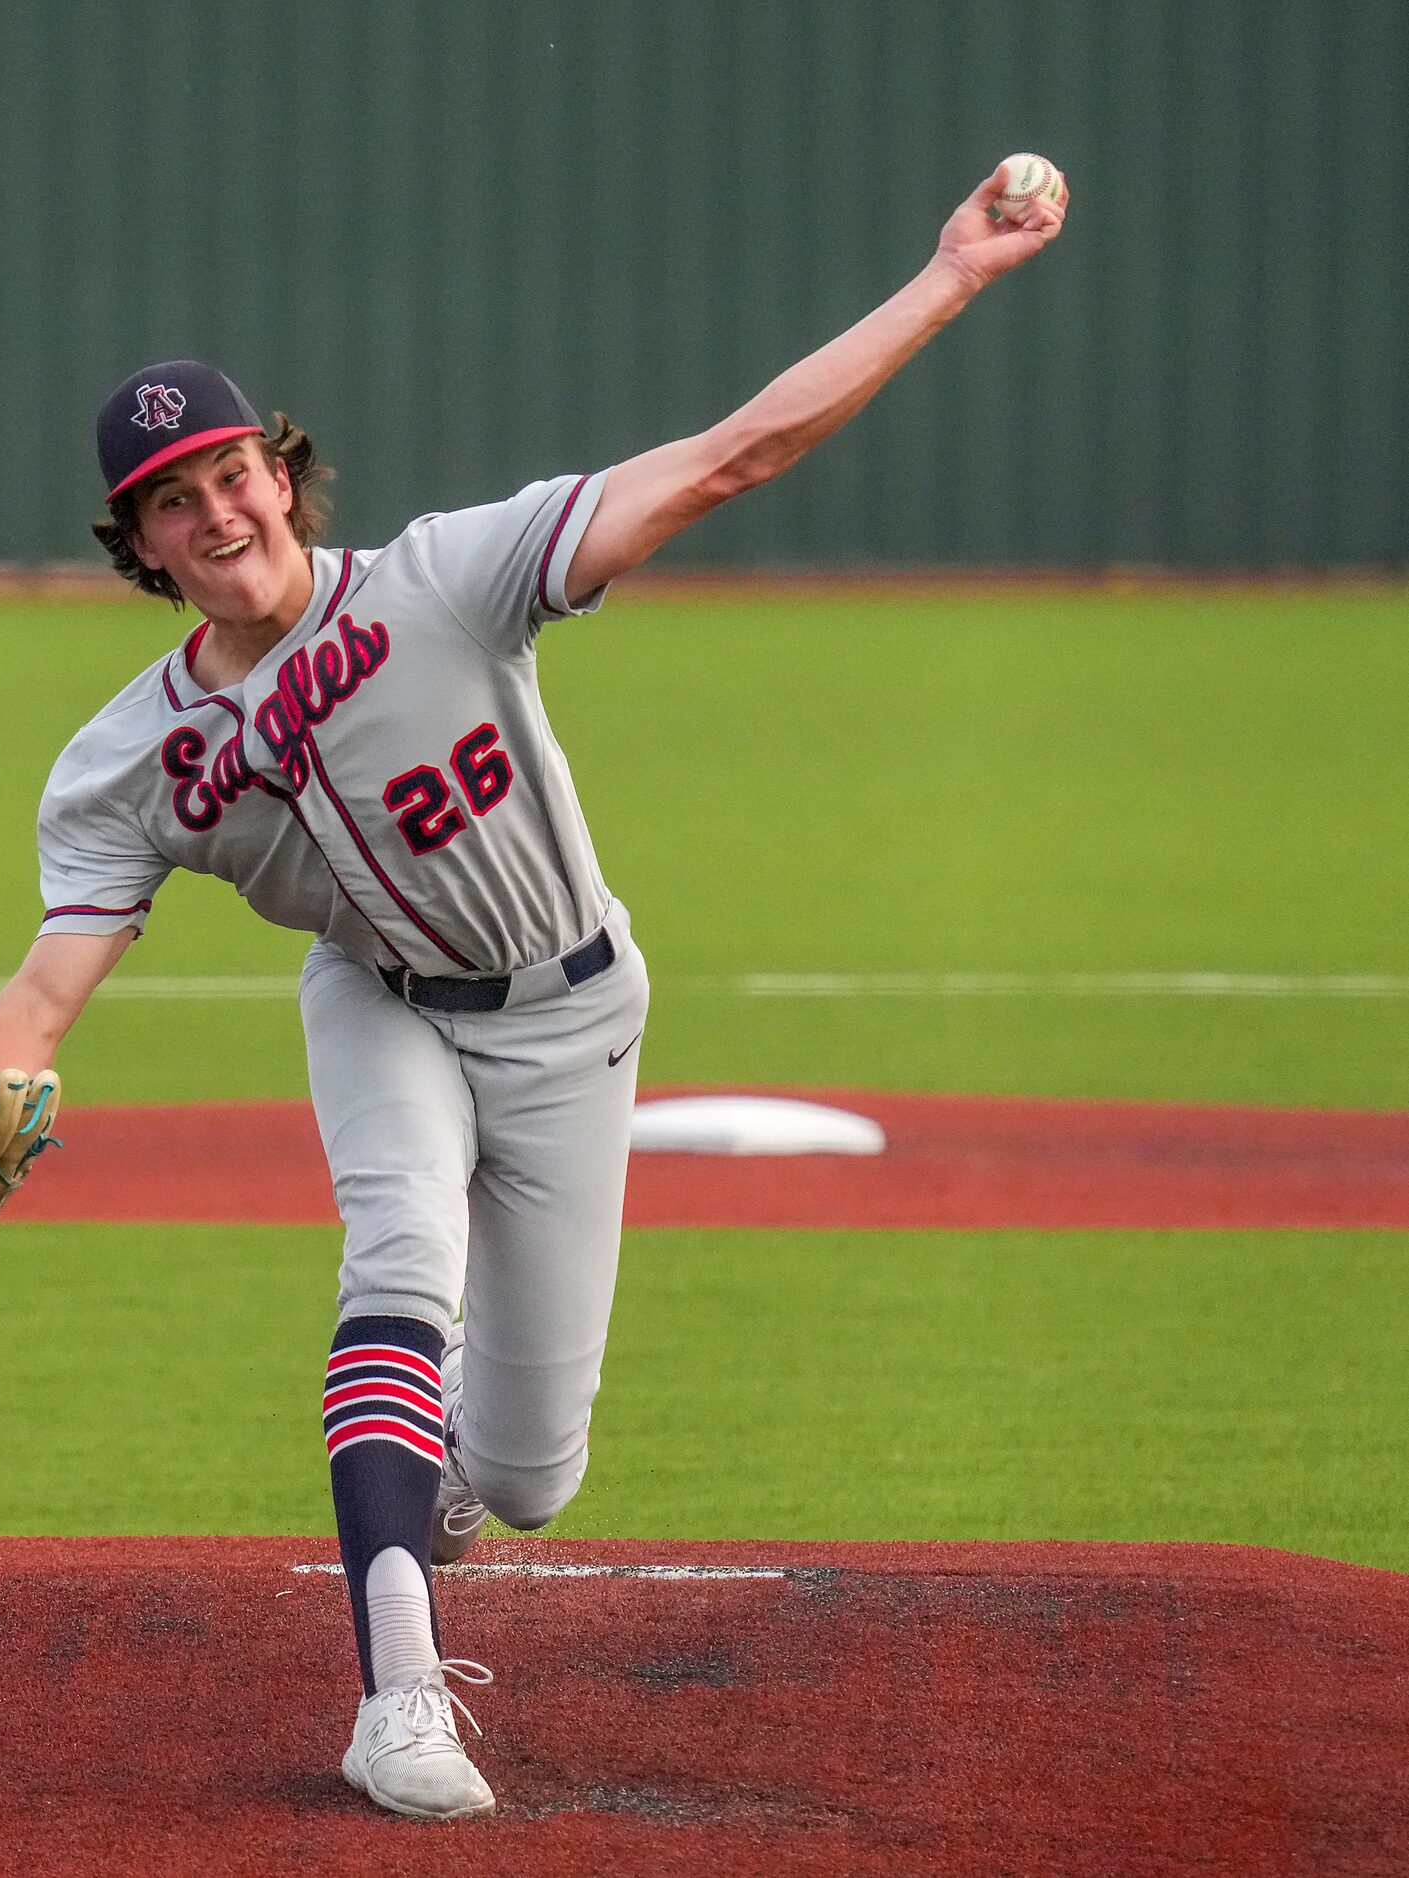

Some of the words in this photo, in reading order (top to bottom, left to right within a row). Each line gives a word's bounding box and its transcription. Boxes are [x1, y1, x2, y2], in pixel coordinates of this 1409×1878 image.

[141, 384, 183, 431] A
[161, 613, 391, 832] Eagles
[382, 722, 513, 856] 26
